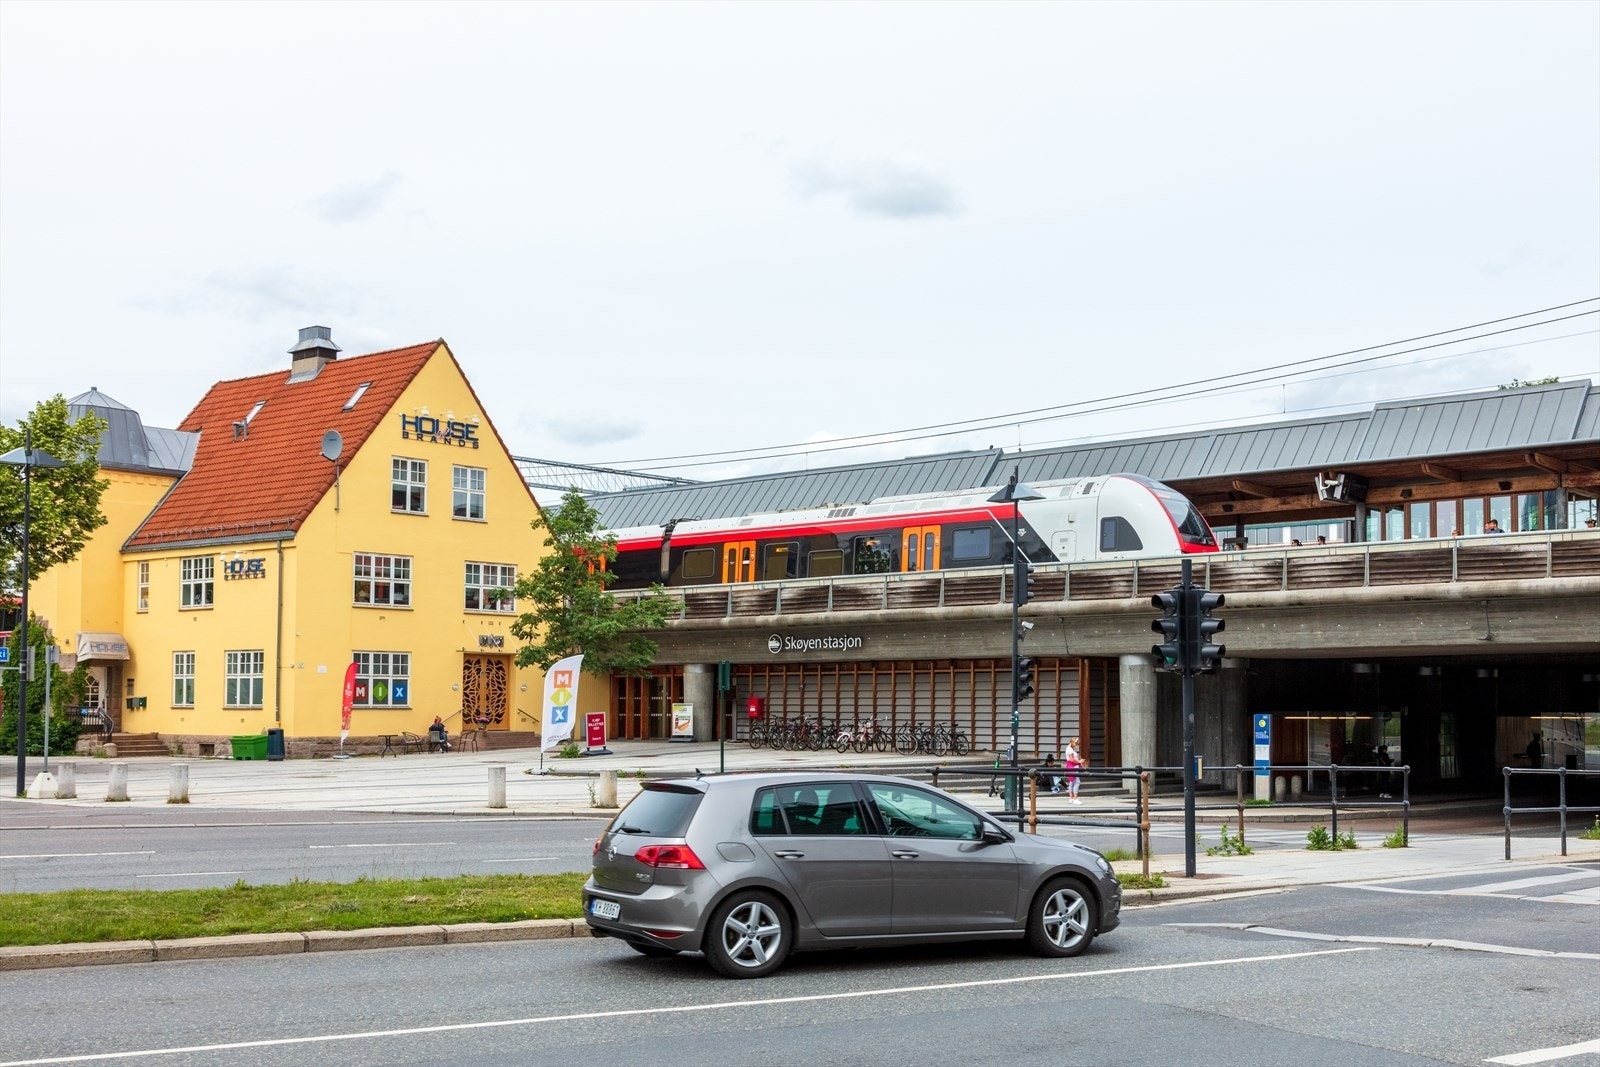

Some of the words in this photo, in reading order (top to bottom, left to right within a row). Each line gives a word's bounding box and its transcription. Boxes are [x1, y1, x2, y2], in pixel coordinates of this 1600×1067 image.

[402, 414, 479, 441] HOUSE
[402, 431, 479, 449] BRANDS
[224, 558, 266, 573] HOUSE
[784, 636, 821, 652] Skøyen
[823, 635, 862, 651] stasjon
[355, 687, 404, 698] MIX
[555, 673, 570, 722] MIX
